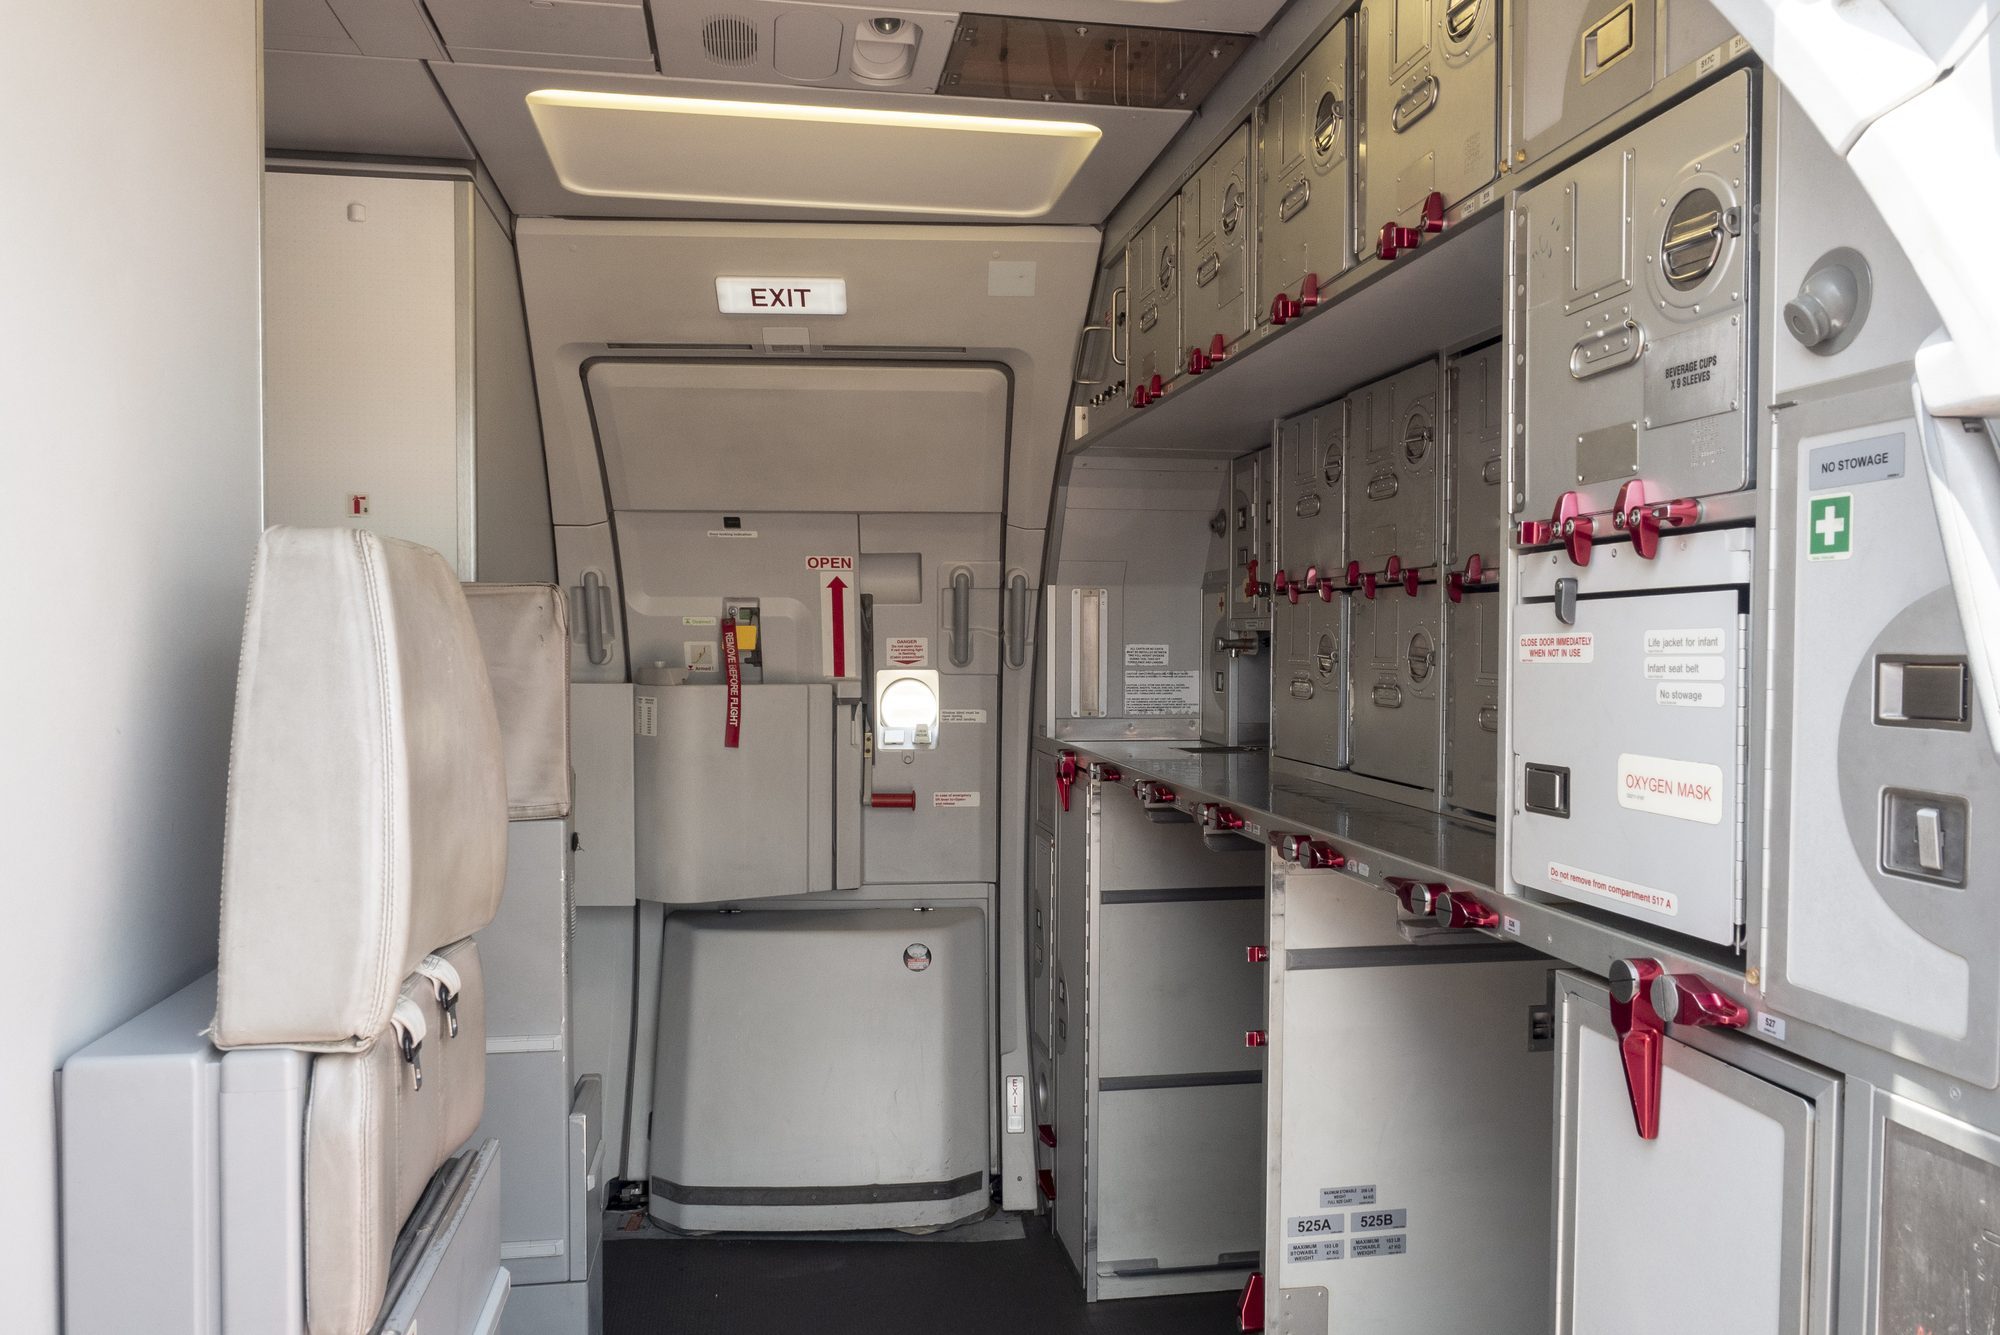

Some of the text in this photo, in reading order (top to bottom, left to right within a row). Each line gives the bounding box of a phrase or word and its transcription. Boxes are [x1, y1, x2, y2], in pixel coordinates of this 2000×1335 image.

[751, 288, 811, 307] EXIT
[1665, 355, 1717, 379] BEVERAGE CUPS
[1671, 370, 1711, 390] X 9 SLEEVES
[1821, 452, 1889, 474] NO STOWAGE
[807, 557, 852, 569] OPEN
[1520, 637, 1592, 646] CLOSE DOOR IMMEDIATELY
[1647, 636, 1718, 649] Life jacket for infant
[1529, 649, 1581, 657] WHEN NOT IN USE
[1647, 664, 1700, 673] Infant seat belt
[725, 631, 739, 727] REMOVE BEFORE FLIGHT
[1660, 689, 1703, 701] No stowage
[1625, 774, 1712, 801] OXYGEN MASK
[1550, 867, 1559, 877] Do
[1560, 871, 1569, 880] not
[1570, 874, 1591, 886] remove
[1592, 879, 1607, 891] from
[1608, 885, 1651, 904] compartment
[1652, 895, 1664, 907] 517
[1666, 899, 1671, 909] A
[1765, 1017, 1776, 1028] 527
[1298, 1219, 1331, 1233] 525A
[1360, 1214, 1393, 1228] 525B
